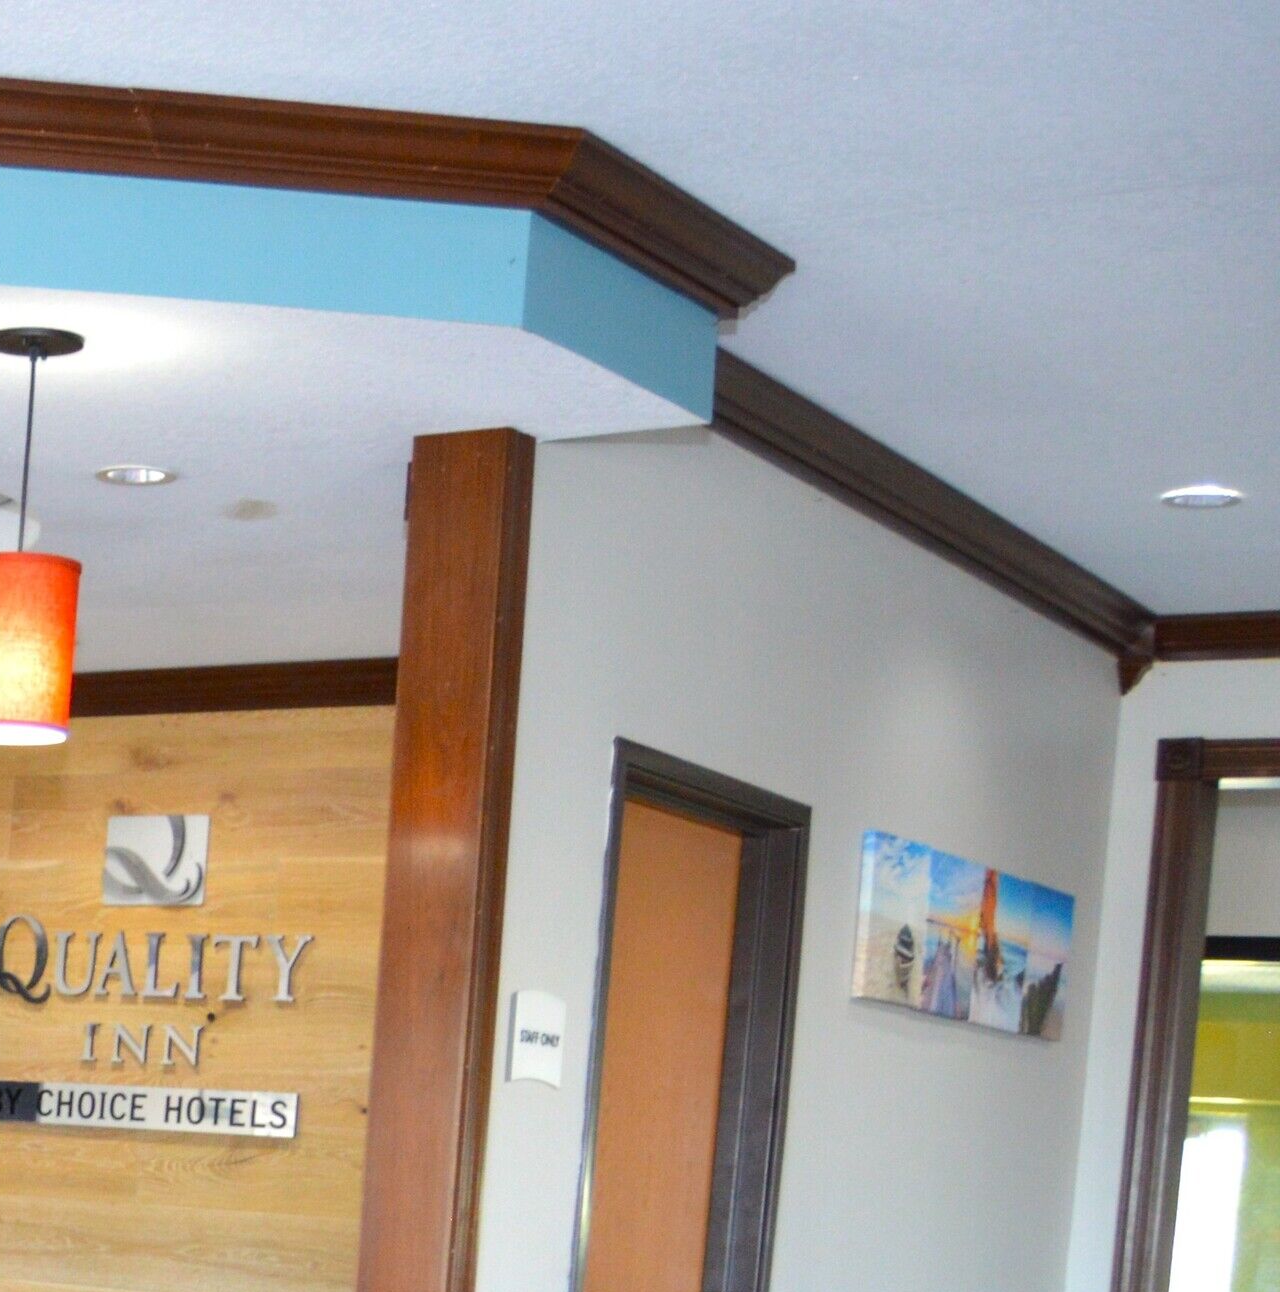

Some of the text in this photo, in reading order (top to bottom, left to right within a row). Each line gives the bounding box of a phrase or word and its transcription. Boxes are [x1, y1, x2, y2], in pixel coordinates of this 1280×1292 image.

[80, 1022, 205, 1066] INN
[520, 1029, 560, 1048] STAFF ONLY
[37, 1089, 148, 1122] CHOICE
[164, 1095, 288, 1129] HOTELS
